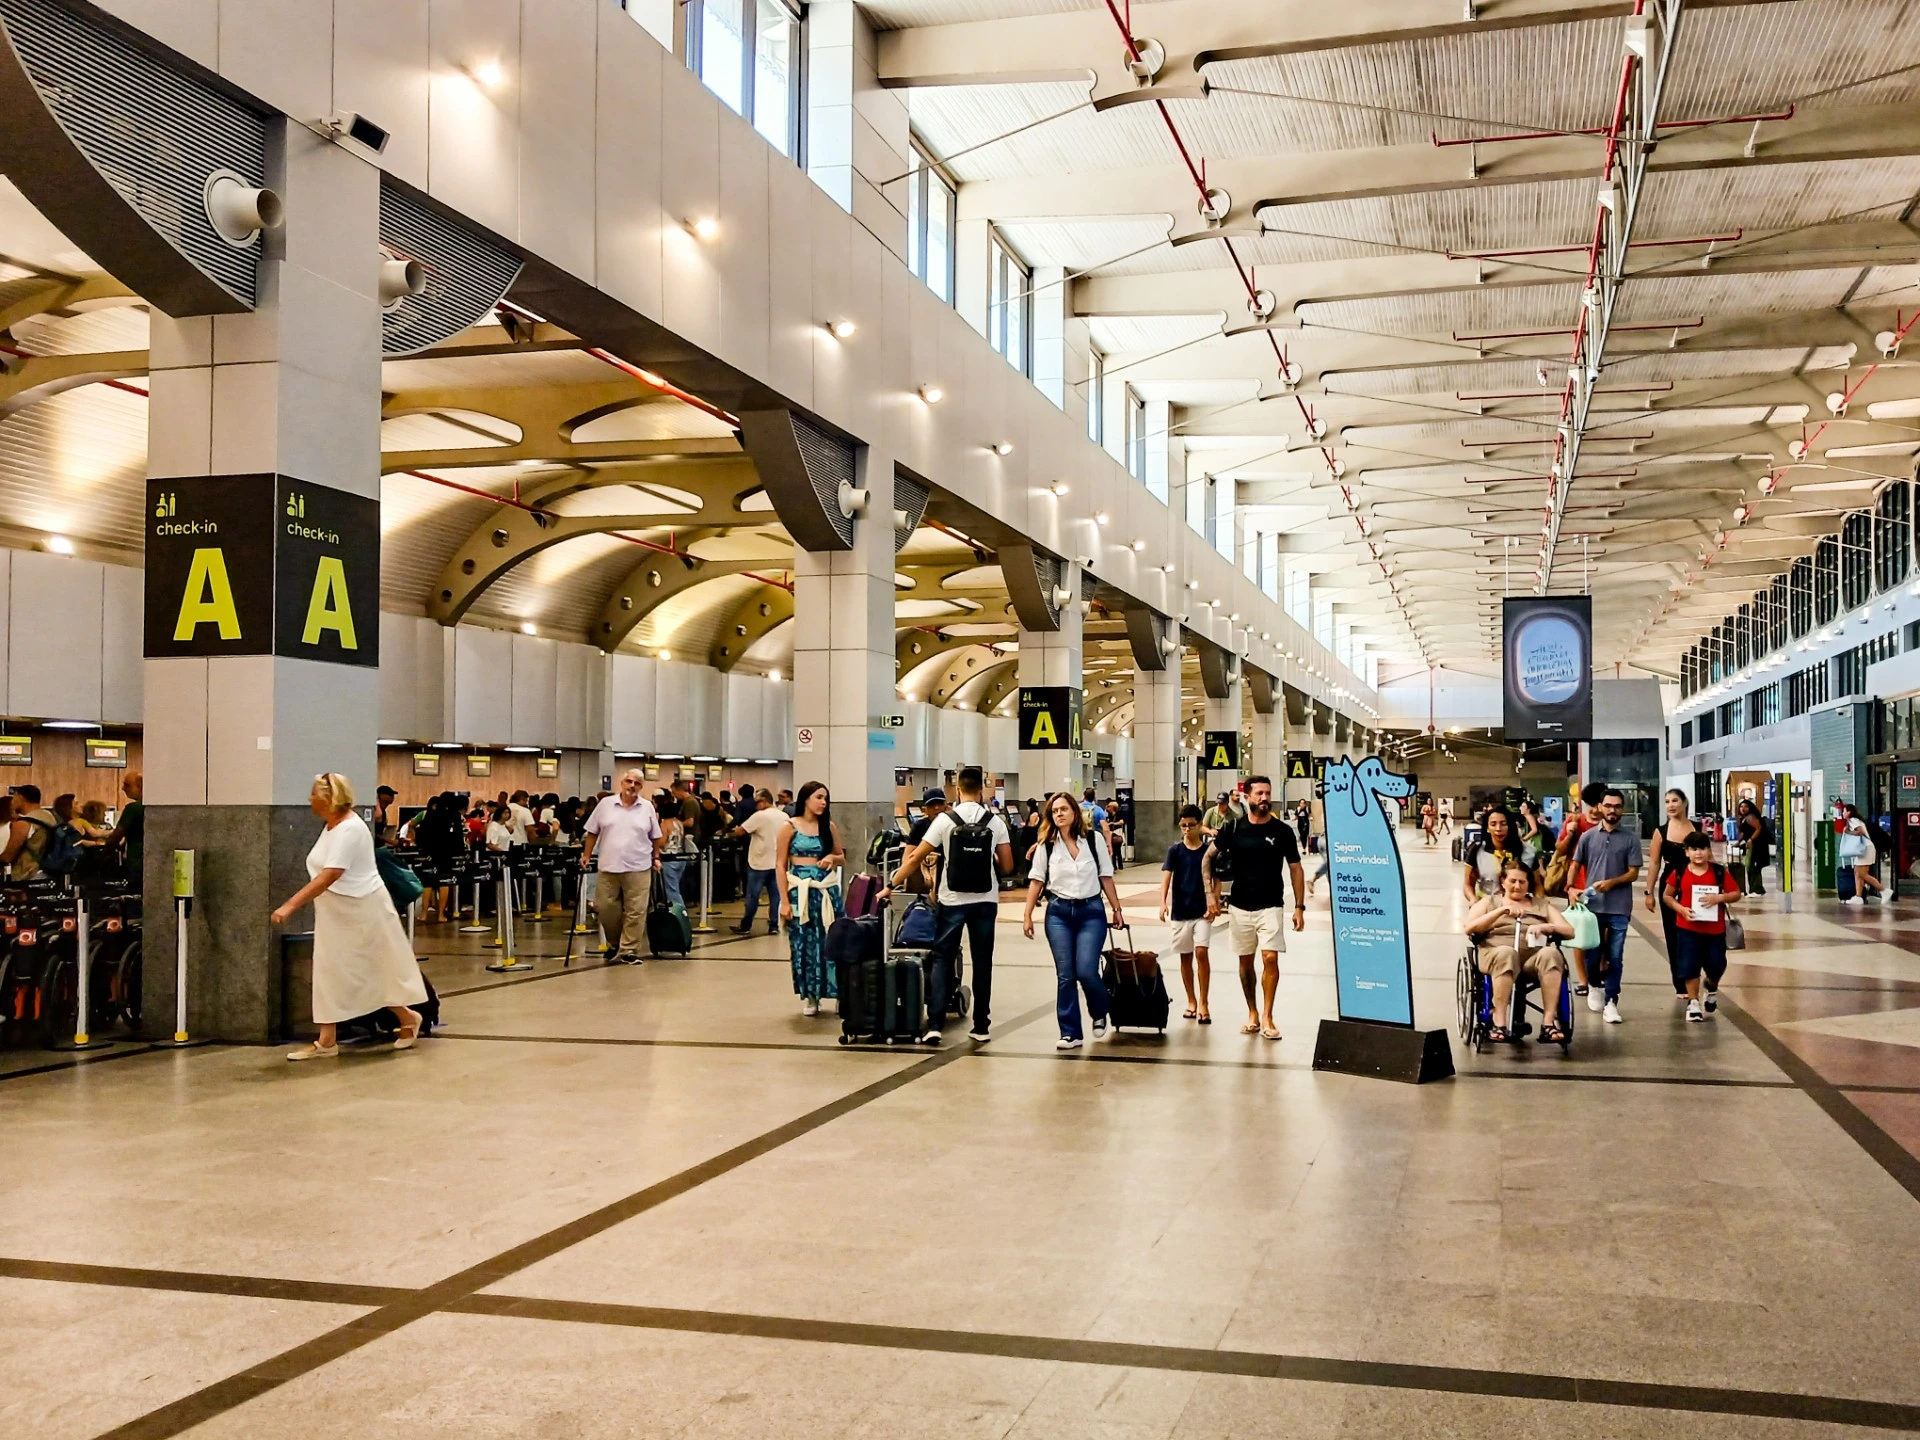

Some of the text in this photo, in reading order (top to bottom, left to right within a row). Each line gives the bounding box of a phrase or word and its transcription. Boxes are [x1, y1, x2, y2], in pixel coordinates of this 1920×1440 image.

[156, 519, 218, 536] check-in
[287, 523, 340, 545] check-in
[173, 547, 242, 641] A
[301, 555, 358, 650] A
[1030, 711, 1058, 745] A
[1072, 712, 1081, 746] A
[1212, 745, 1230, 767] A
[1292, 761, 1306, 777] A
[1334, 842, 1362, 854] Sejam
[1335, 854, 1390, 865] bem-vindos!
[1337, 872, 1362, 883] Pet só
[1349, 884, 1368, 894] guia
[1338, 894, 1372, 904] caixa de
[1339, 905, 1386, 917] transporte.
